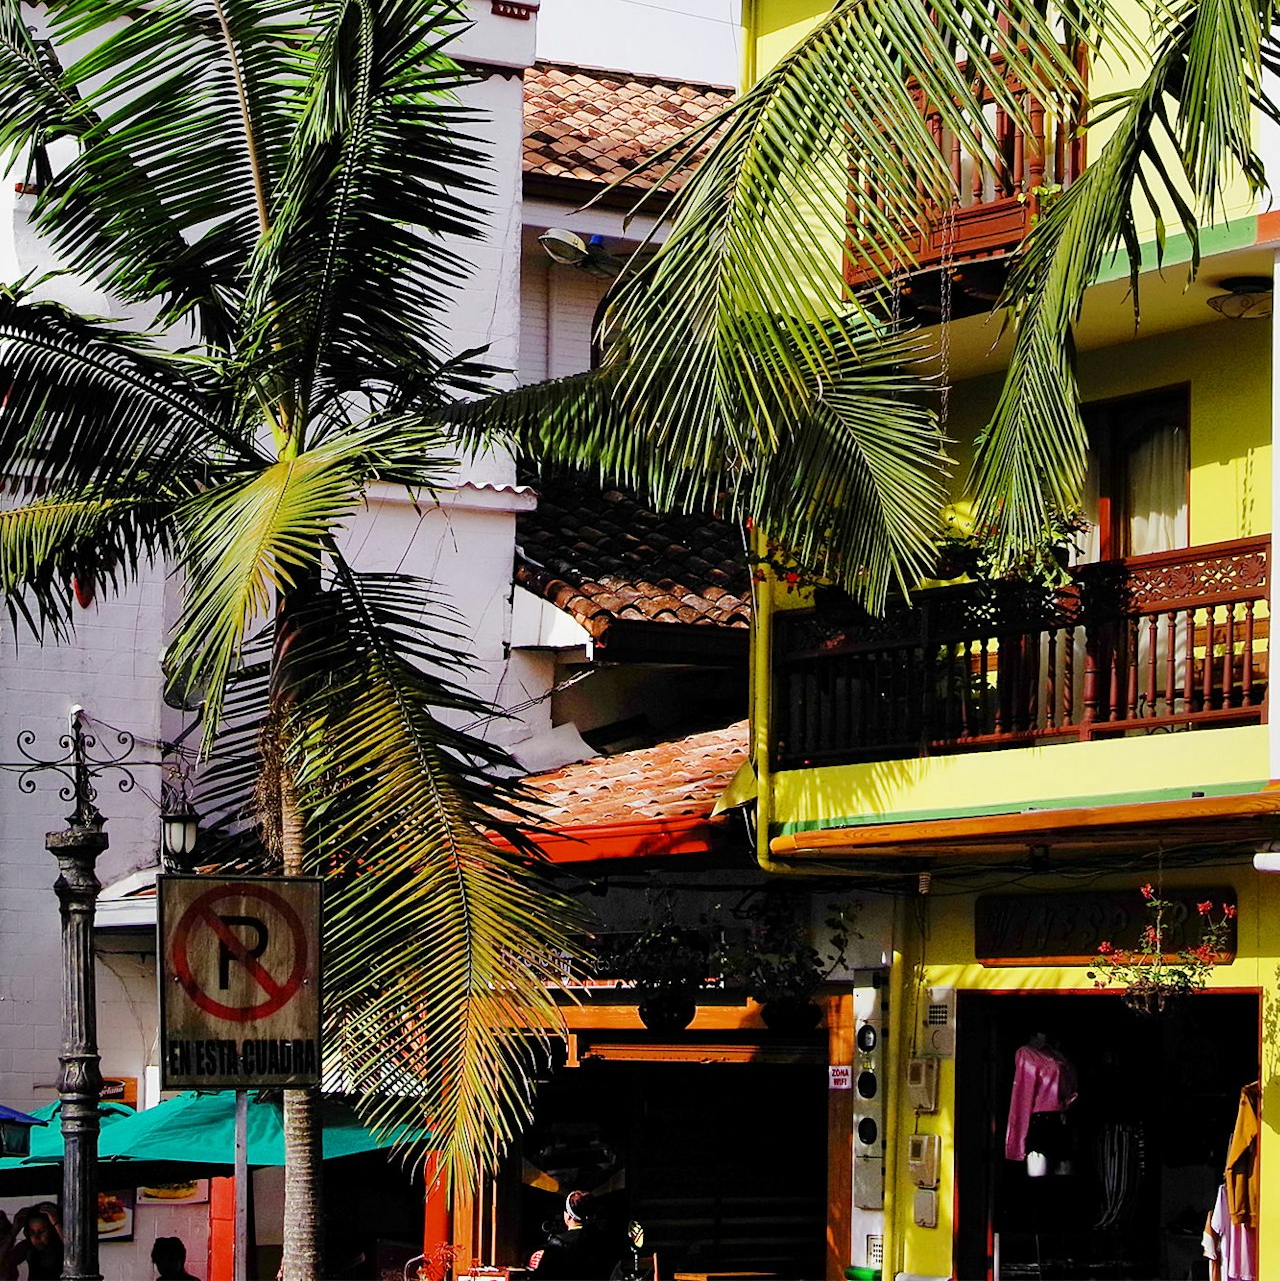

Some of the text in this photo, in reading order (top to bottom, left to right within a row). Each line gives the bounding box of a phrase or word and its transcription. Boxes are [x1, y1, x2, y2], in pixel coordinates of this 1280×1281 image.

[219, 915, 268, 990] P
[170, 1038, 317, 1076] EN ESTA CUADRA
[832, 1068, 849, 1077] ZONA
